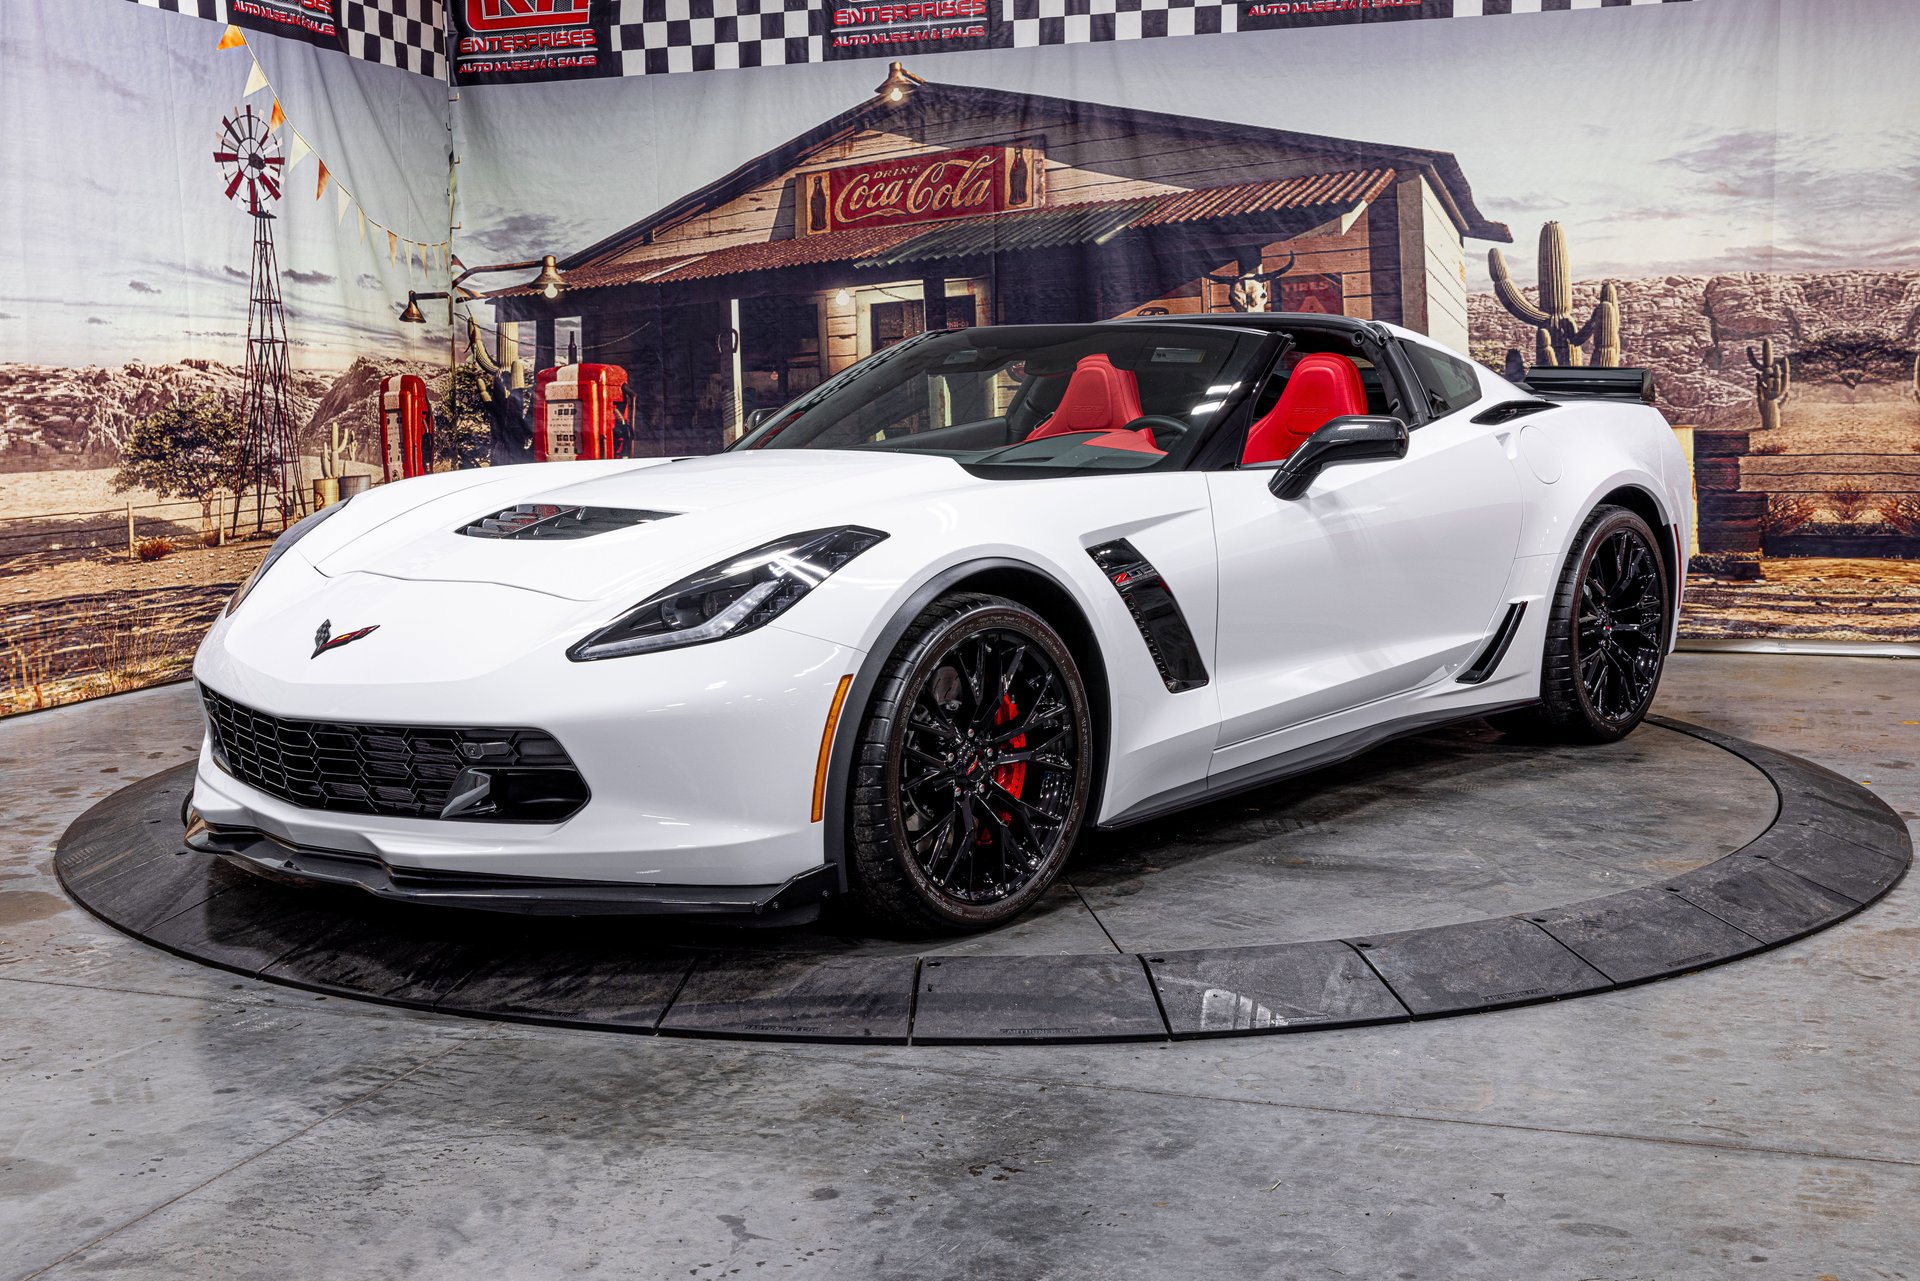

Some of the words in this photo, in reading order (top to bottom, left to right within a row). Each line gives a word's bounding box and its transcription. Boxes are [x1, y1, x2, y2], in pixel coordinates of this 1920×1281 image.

[233, 0, 259, 16] AUTO
[260, 6, 301, 26] MUSEUM
[833, 0, 987, 26] ENTERPRISES
[1248, 3, 1291, 17] AUTO
[1292, 0, 1357, 15] MUSEUM
[459, 28, 597, 53] ENTERPRISES
[833, 34, 870, 47] AUTO
[870, 31, 929, 44] MUSEUM
[930, 28, 940, 41] &
[941, 25, 985, 40] SALES
[459, 62, 493, 74] AUTO
[494, 58, 546, 73] MUSEUM
[548, 57, 557, 69] &
[558, 55, 597, 68] SALES
[873, 164, 921, 179] DRINK
[1281, 281, 1329, 293] TIRES
